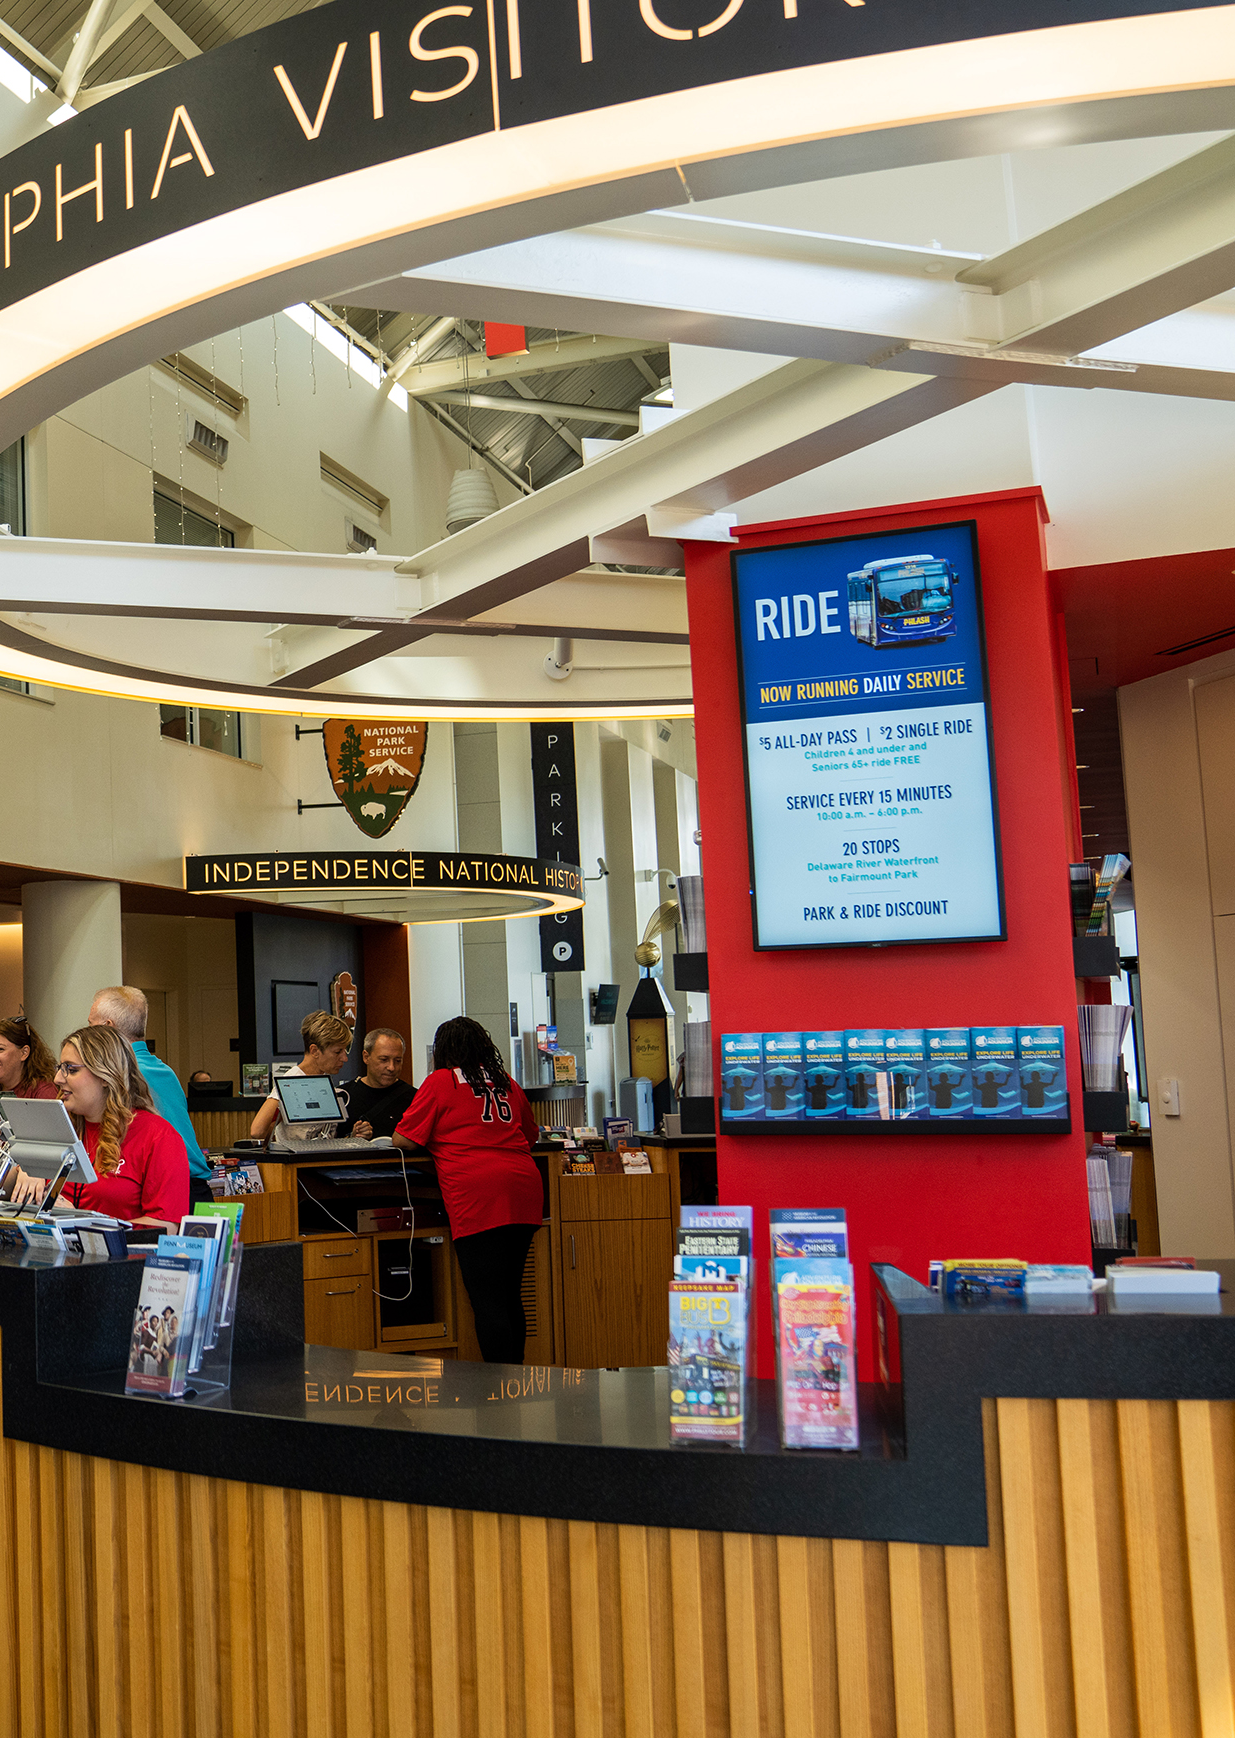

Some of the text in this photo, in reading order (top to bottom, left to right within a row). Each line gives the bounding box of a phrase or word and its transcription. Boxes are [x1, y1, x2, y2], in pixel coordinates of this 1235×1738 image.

[273, 0, 866, 141] VISI
[755, 590, 841, 641] RIDE
[903, 616, 930, 626] PHLASH
[760, 668, 965, 703] NOW RUNNING DAILY SERVICE
[364, 725, 419, 737] NATIONAL
[879, 719, 973, 740] $2 SINGLE RIDE
[377, 737, 405, 746] PARK
[759, 728, 858, 750] $5 ALL-DAY PASS
[369, 746, 414, 757] SERVICE
[804, 750, 846, 760] Children
[856, 746, 874, 755] and
[876, 744, 906, 754] under
[908, 741, 927, 751] and
[812, 755, 921, 772] Seniors 65+ ride FREE
[786, 784, 952, 810] SERVICE EVERY 15 MINUTES
[817, 807, 923, 821] 10:00 a.m. 6:00 p.m.
[842, 838, 900, 856] 20 STOPS
[807, 856, 939, 872] Delaware River Waterfront
[205, 858, 425, 884] INDEPENDENCE
[438, 860, 539, 886] NATIONAL
[828, 869, 919, 883] to Fairmount Park
[803, 900, 949, 921] PARK & RIDE DISCOUNT
[558, 947, 567, 956] P
[471, 1086, 513, 1123] 76
[689, 1216, 745, 1227] HISTORY
[685, 1235, 739, 1245] EASTERN STATE
[801, 1244, 838, 1253] CHINESE
[150, 1273, 181, 1282] Rediscover
[147, 1285, 180, 1295] Revolution!
[679, 1296, 708, 1311] BIG
[679, 1311, 708, 1325] BUS
